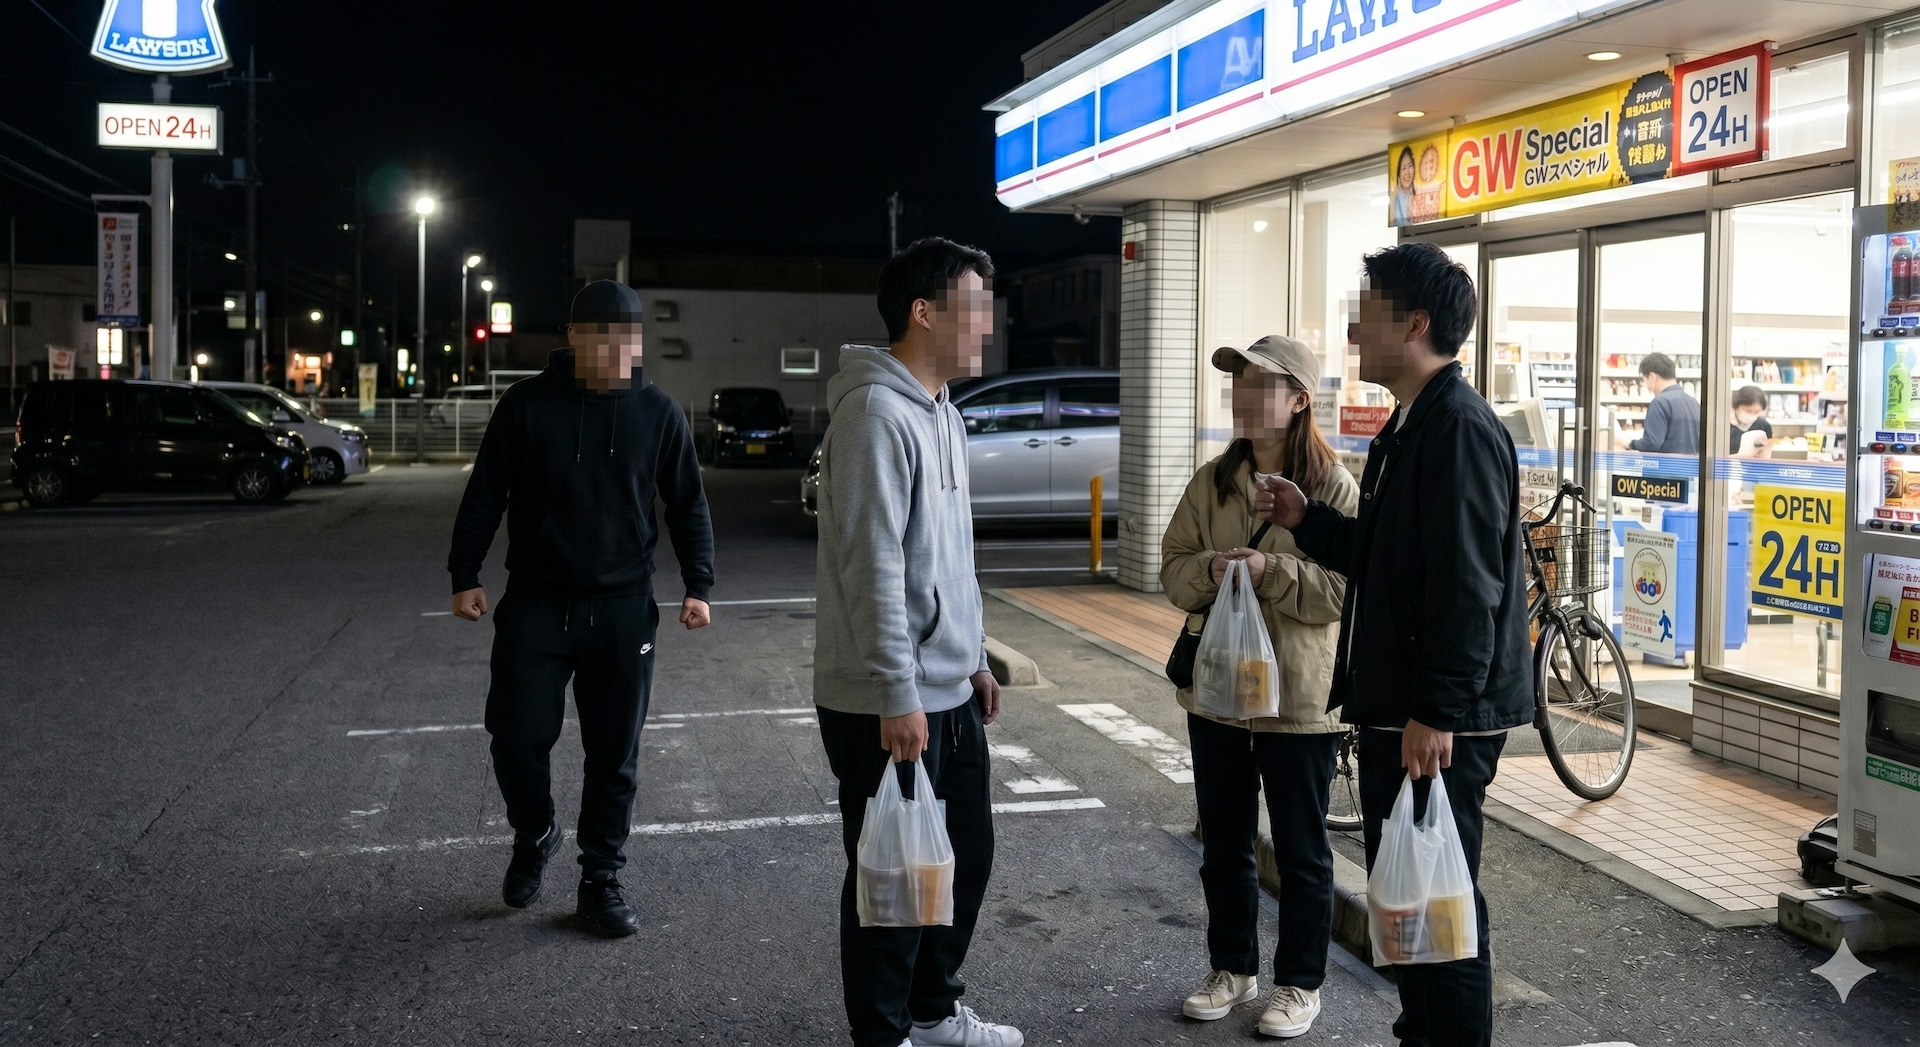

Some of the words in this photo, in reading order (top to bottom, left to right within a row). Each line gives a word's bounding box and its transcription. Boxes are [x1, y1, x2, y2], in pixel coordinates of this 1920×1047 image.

[110, 32, 209, 57] LAWSON
[1690, 67, 1748, 104] OPEN
[105, 116, 161, 136] OPEN
[166, 116, 211, 139] 24H
[1688, 105, 1748, 153] 24H
[1453, 128, 1523, 199] GW
[1525, 111, 1610, 165] Special
[1524, 152, 1610, 186] GWスペシャル
[1617, 478, 1638, 495] OW
[1640, 480, 1681, 499] Special
[1772, 494, 1832, 525] OPEN
[1758, 530, 1840, 599] 24H
